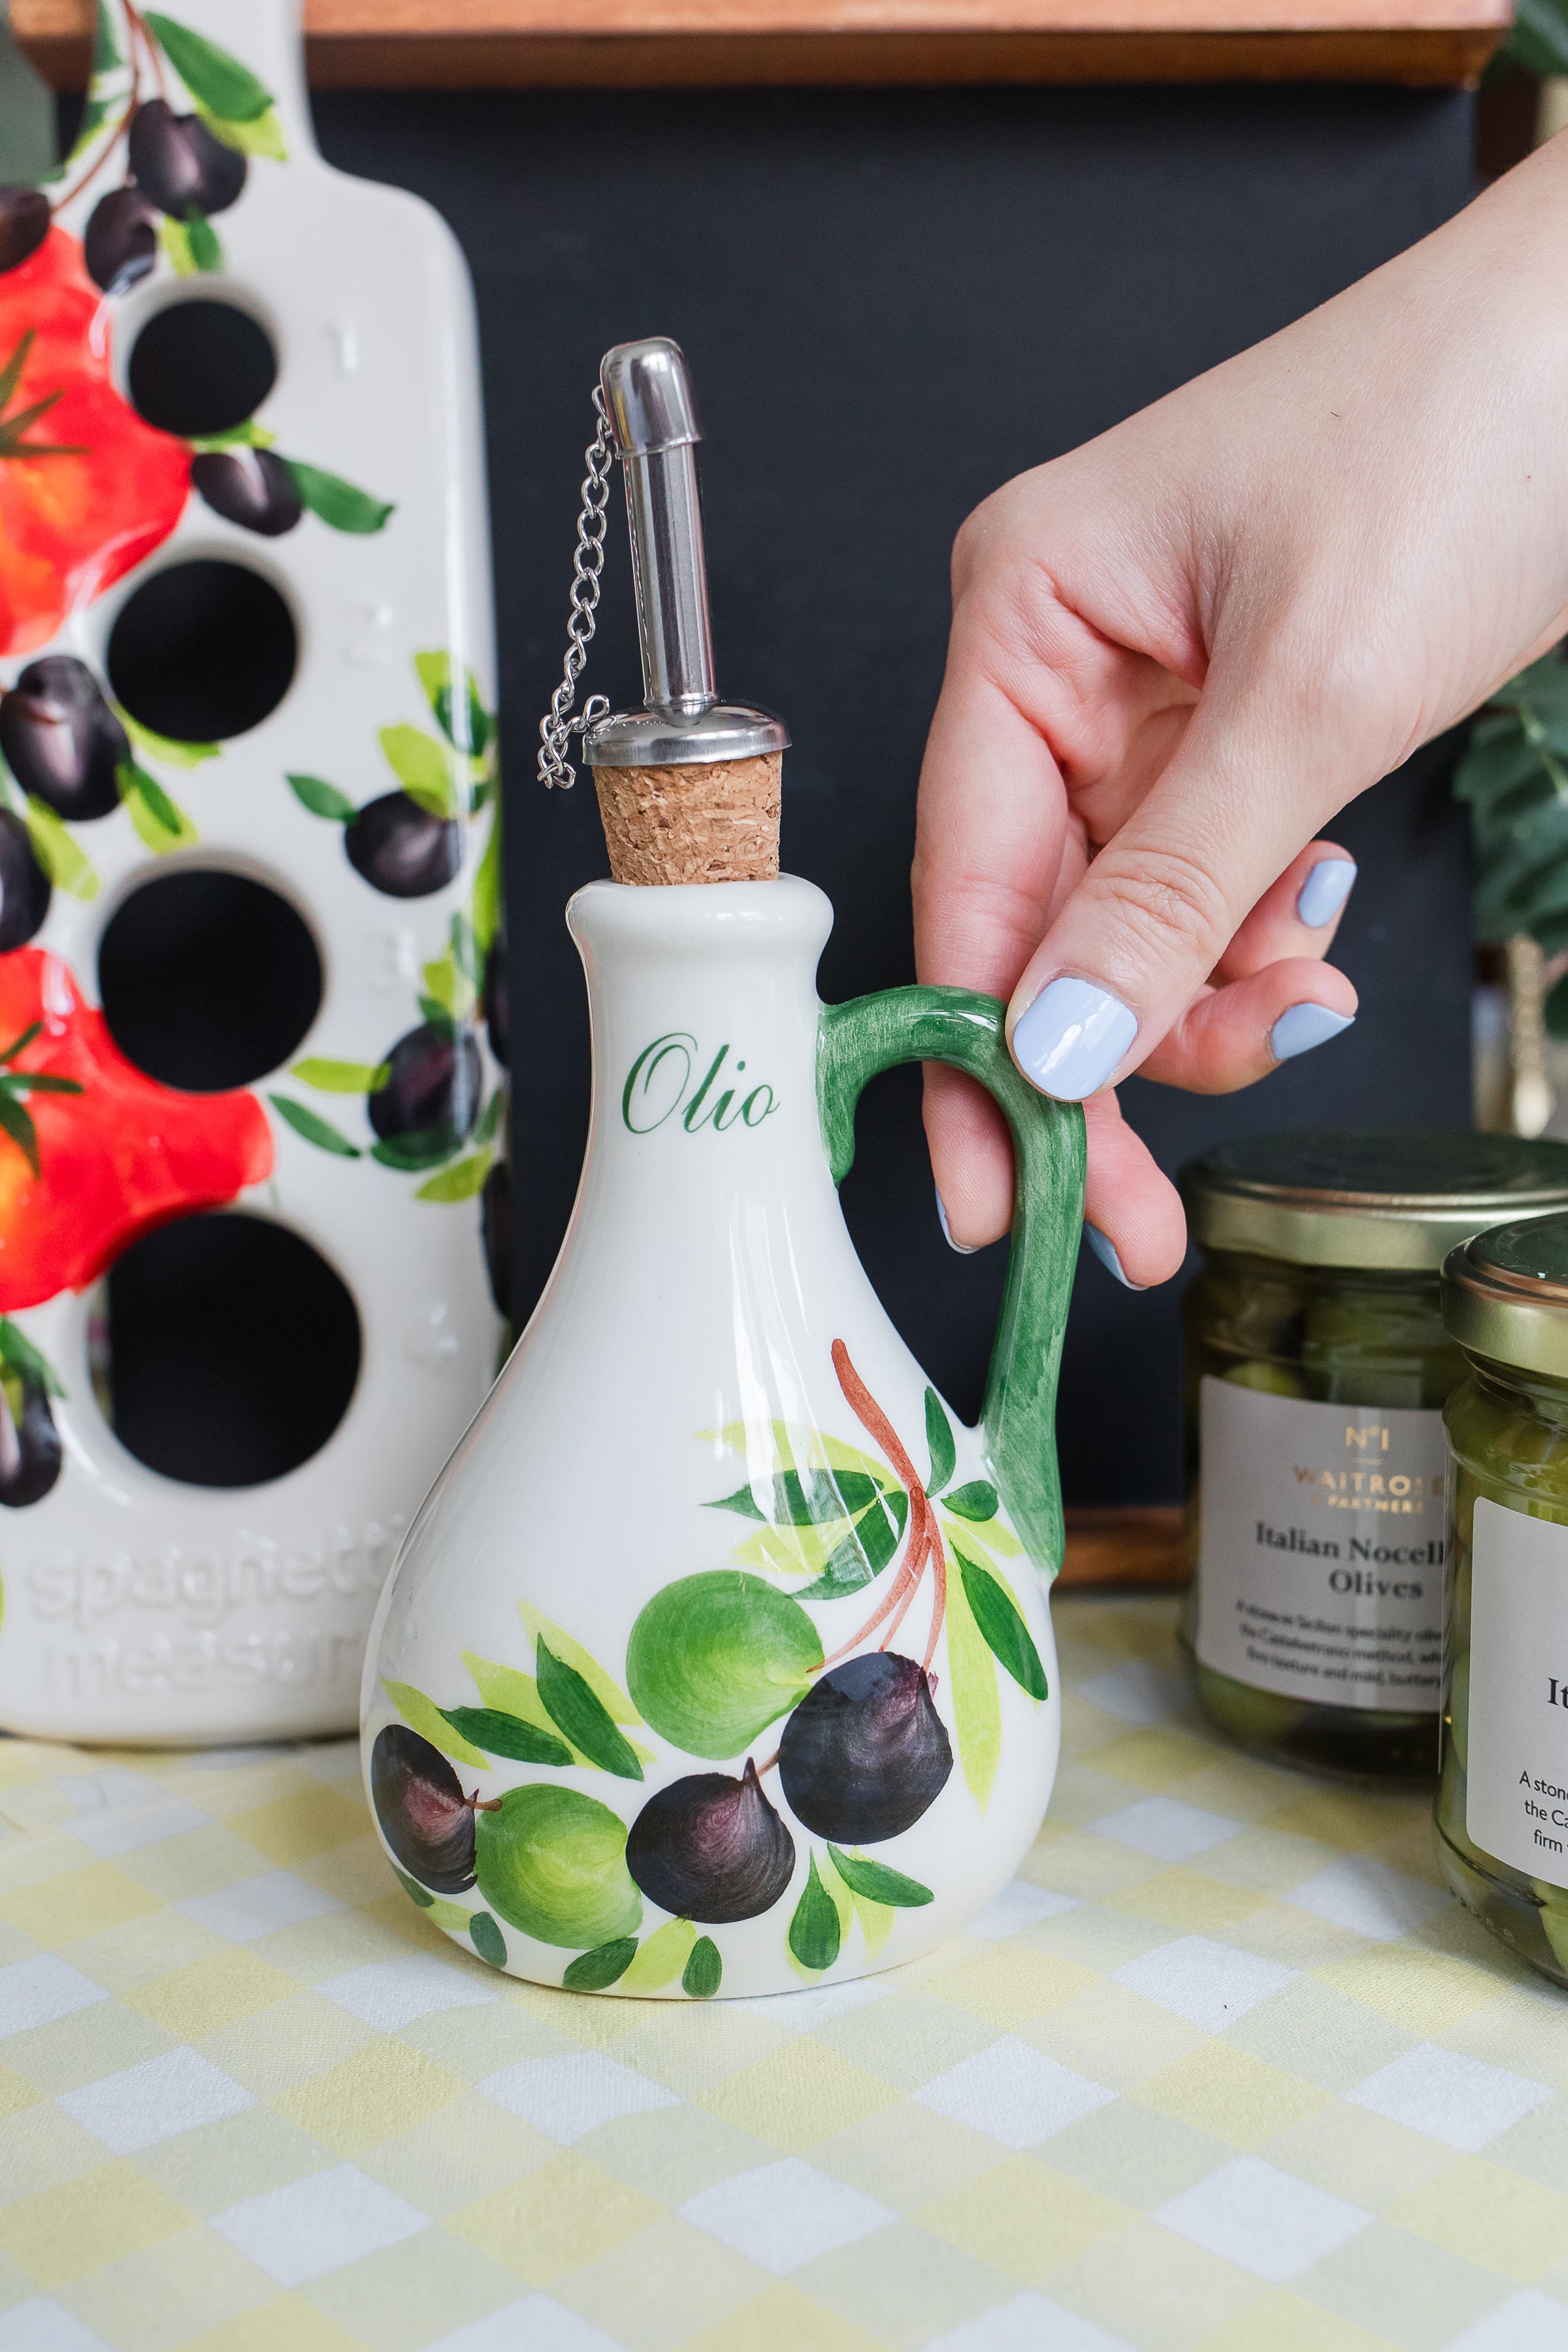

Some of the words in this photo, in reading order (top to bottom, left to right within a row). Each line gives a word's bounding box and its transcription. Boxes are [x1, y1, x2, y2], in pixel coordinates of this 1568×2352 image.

[621, 1032, 781, 1134] Olio
[1256, 1520, 1341, 1560] Italian
[1348, 1536, 1444, 1566] Nocell
[27, 1513, 402, 1633] spaghett
[1328, 1567, 1424, 1600] Olives
[1547, 1677, 1568, 1709] It
[1519, 1770, 1531, 1788] A
[1534, 1780, 1568, 1801] ston
[1524, 1800, 1548, 1820] the
[1533, 1829, 1562, 1853] firm
